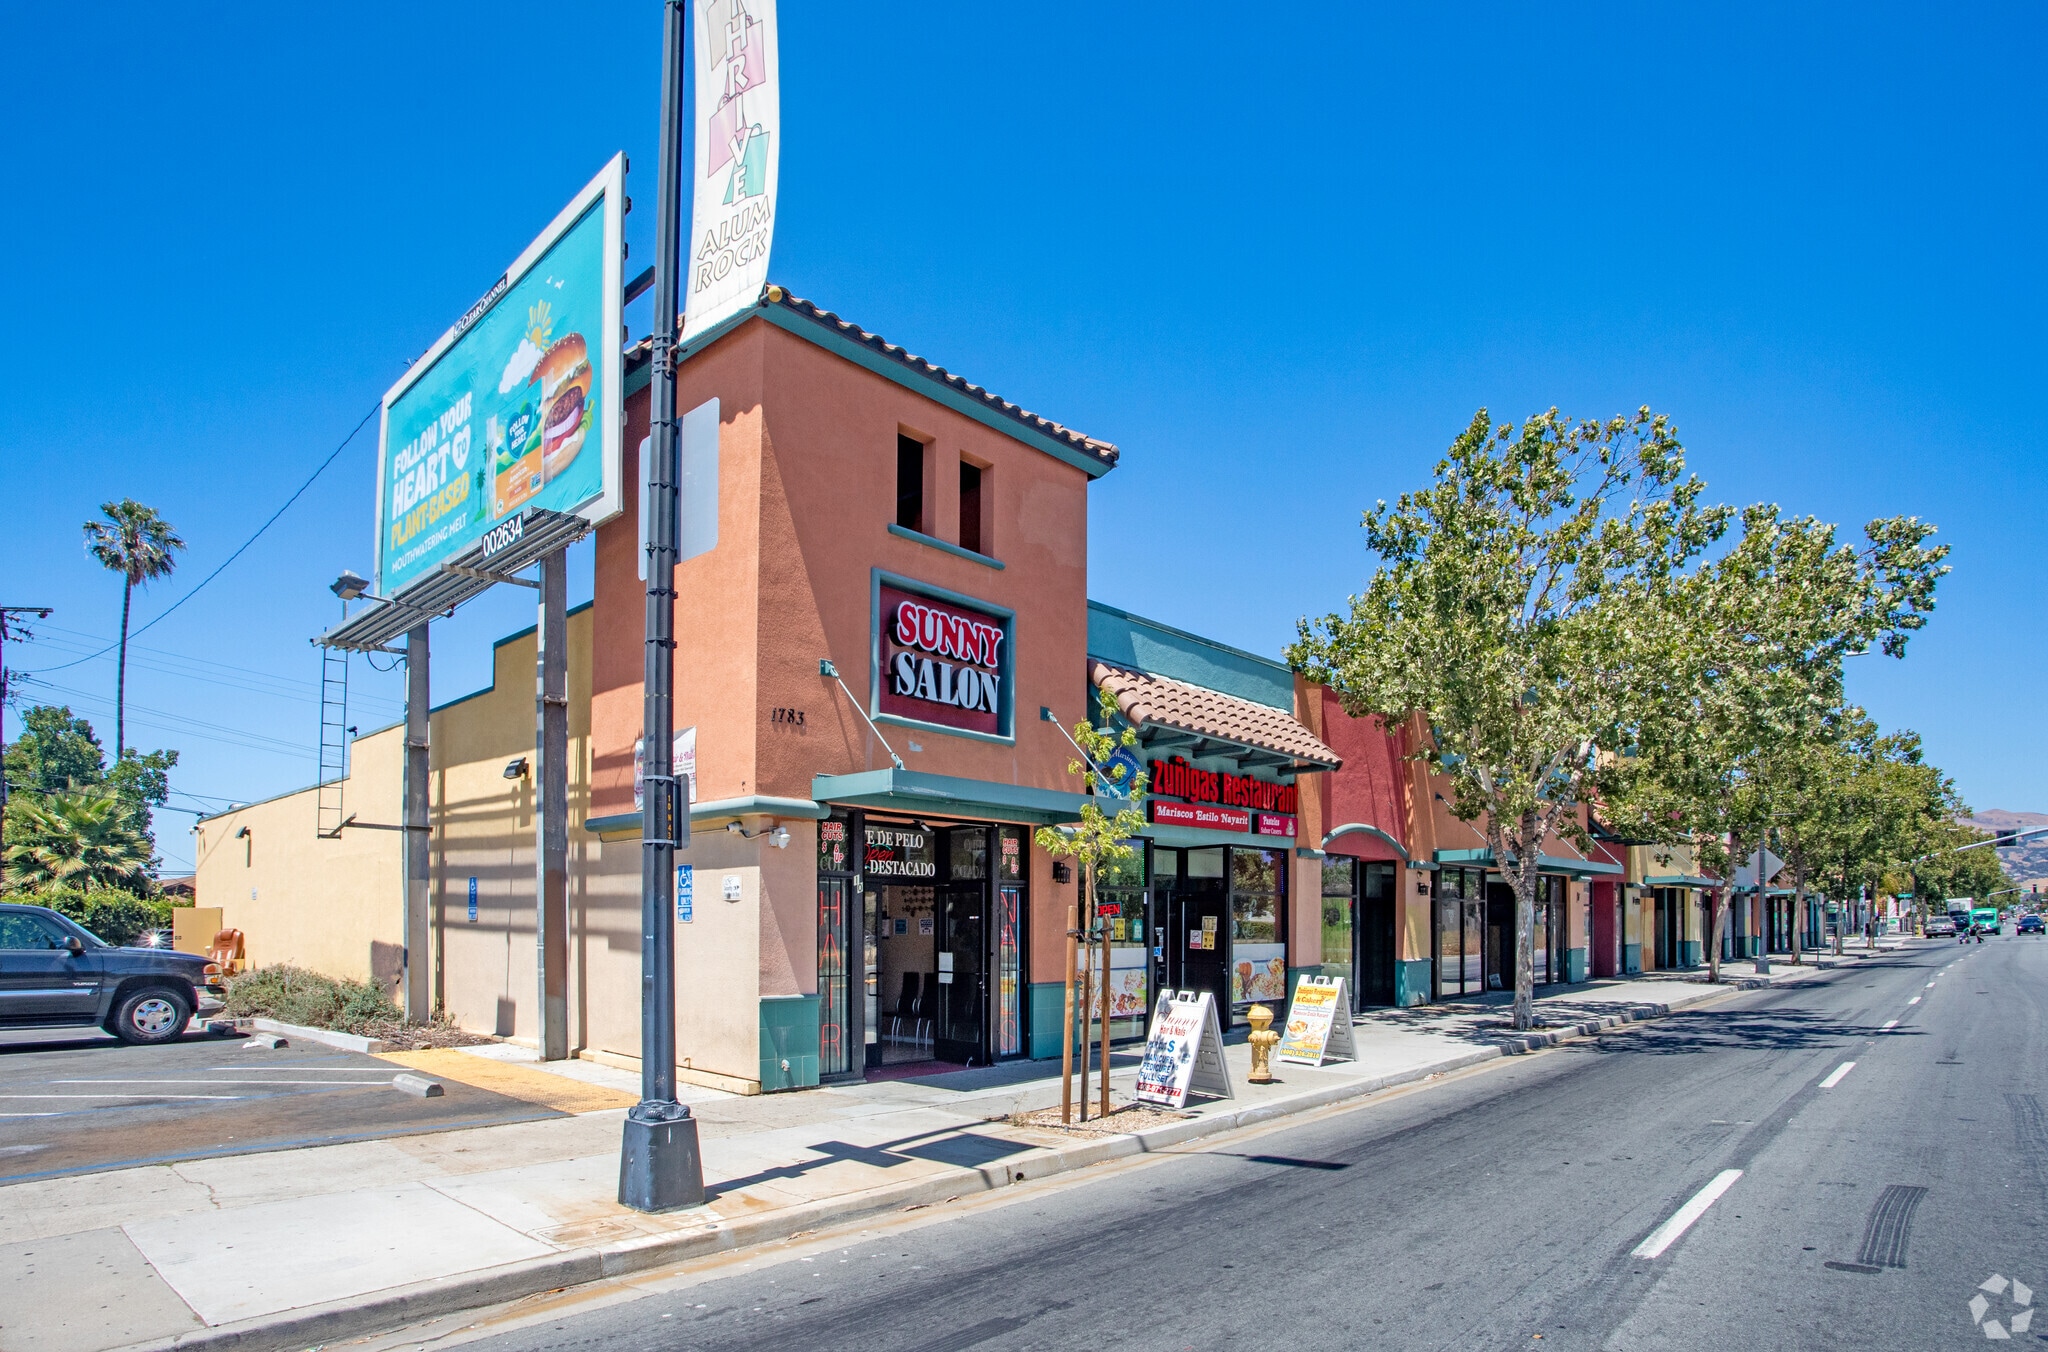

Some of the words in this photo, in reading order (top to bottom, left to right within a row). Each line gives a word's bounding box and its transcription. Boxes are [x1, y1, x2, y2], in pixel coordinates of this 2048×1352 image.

[697, 195, 771, 261] ALUM
[695, 228, 767, 293] ROCK
[509, 414, 530, 436] FOLLOW
[514, 425, 525, 439] YOUR
[393, 421, 438, 480] FOLLOW
[440, 391, 472, 440] YOUR
[511, 435, 527, 451] HEART
[392, 441, 450, 521] HEART
[456, 437, 468, 456] TO
[391, 471, 470, 551] PLANT-BASED
[392, 527, 448, 574] MOUTHWATERING
[450, 512, 467, 537] MELT
[483, 515, 523, 557] 002634
[897, 601, 1003, 668] SUNNY
[896, 652, 1000, 713] SALON
[771, 708, 805, 726] 1783
[1154, 756, 1219, 802] Zuñigas
[1223, 772, 1298, 814] Restaurant
[1156, 805, 1194, 819] Mariscos
[1196, 810, 1219, 822] Estilo
[1221, 813, 1248, 826] Nayarit
[822, 822, 843, 831] HAIR
[822, 831, 843, 841] CUTS
[877, 831, 893, 846] DE
[895, 832, 923, 849] PELO
[1003, 838, 1018, 847] HAIR
[833, 852, 844, 863] UP
[1002, 846, 1018, 855] CUTS
[870, 860, 935, 877] DESTACADO
[1097, 903, 1121, 916] OPEN
[1157, 1006, 1198, 1032] Sunny
[1167, 1040, 1175, 1053] $
[1142, 1061, 1171, 1074] PEDICURE
[1144, 1053, 1174, 1065] MANICURE
[1140, 1071, 1154, 1081] FULL
[1157, 1074, 1169, 1083] SET
